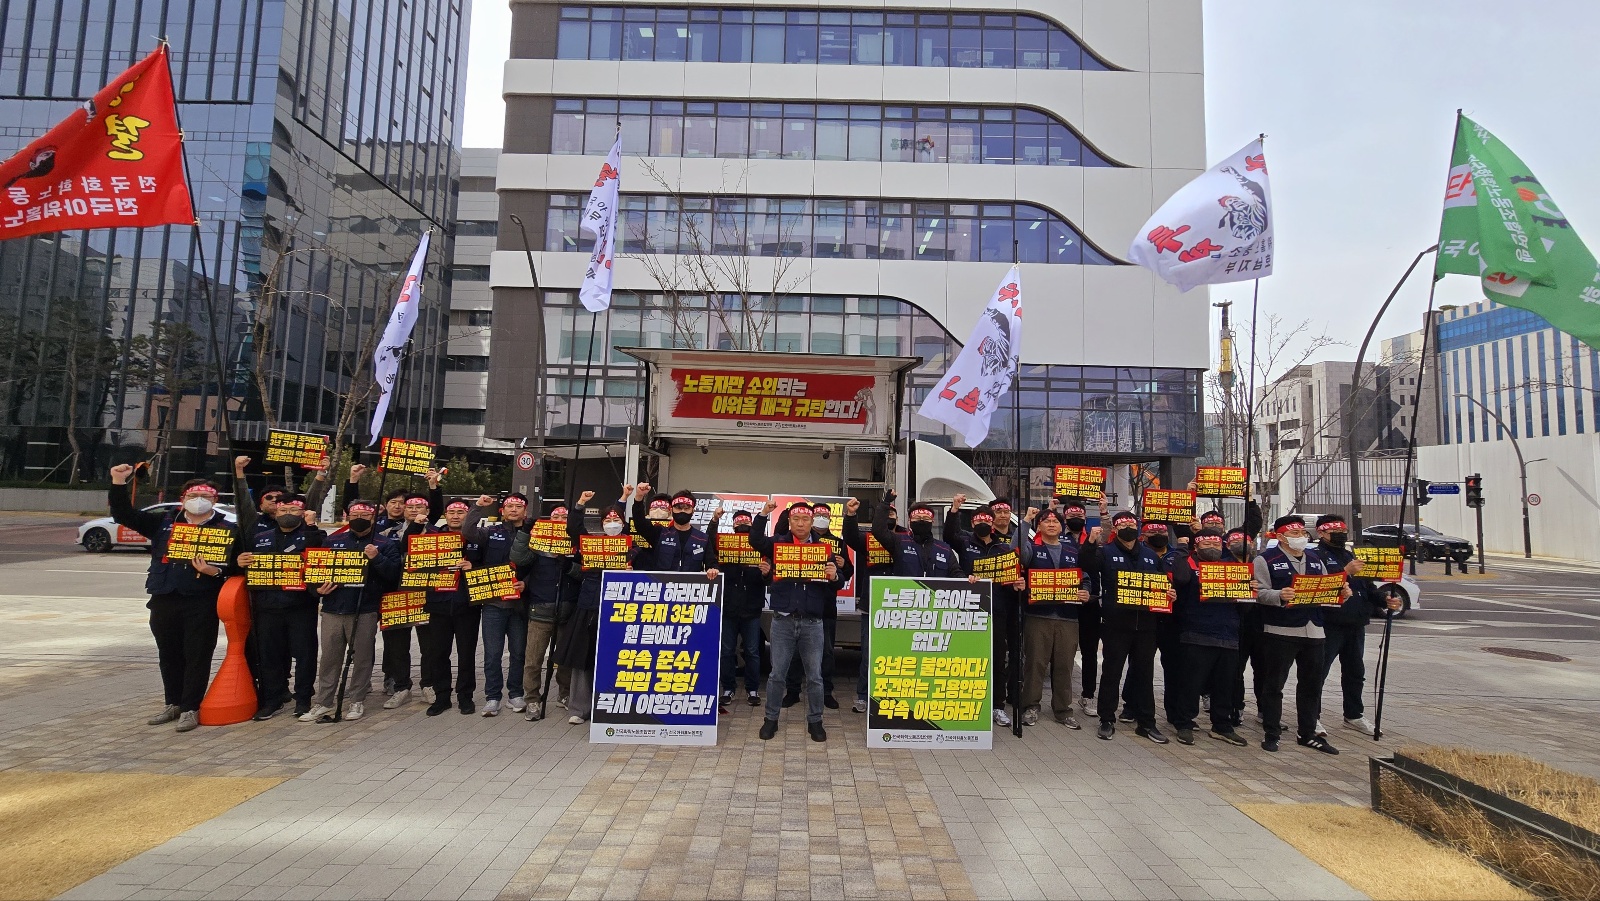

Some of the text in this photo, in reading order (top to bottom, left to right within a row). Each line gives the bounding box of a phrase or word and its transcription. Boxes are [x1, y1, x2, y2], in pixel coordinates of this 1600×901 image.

[683, 374, 808, 396] 노동자만 소외되는
[712, 396, 864, 418] 아워홈 매각 규탄한다!
[521, 457, 530, 466] 30
[174, 526, 230, 536] 절대안심 하라더니
[184, 534, 198, 542] 고용
[603, 581, 718, 602] 절대 안심 하라더니
[882, 588, 982, 610] 노동자 없이는
[1117, 596, 1141, 605] 고용안정
[1118, 588, 1142, 597] 경영진이
[610, 603, 708, 624] 고용 유지 3년이
[874, 610, 989, 631] 아워홈의 미래도
[623, 624, 692, 645] 웬 말이냐?
[911, 632, 952, 652] 없다!
[617, 650, 700, 670] 약속 준수!
[874, 656, 988, 678] 3년은 불안하다!
[615, 671, 698, 692] 책임 경영!
[873, 678, 988, 700] 조건없는 고용안정
[596, 693, 715, 716] 즉시 이행하라!
[878, 700, 982, 721] 약속 이행하라!
